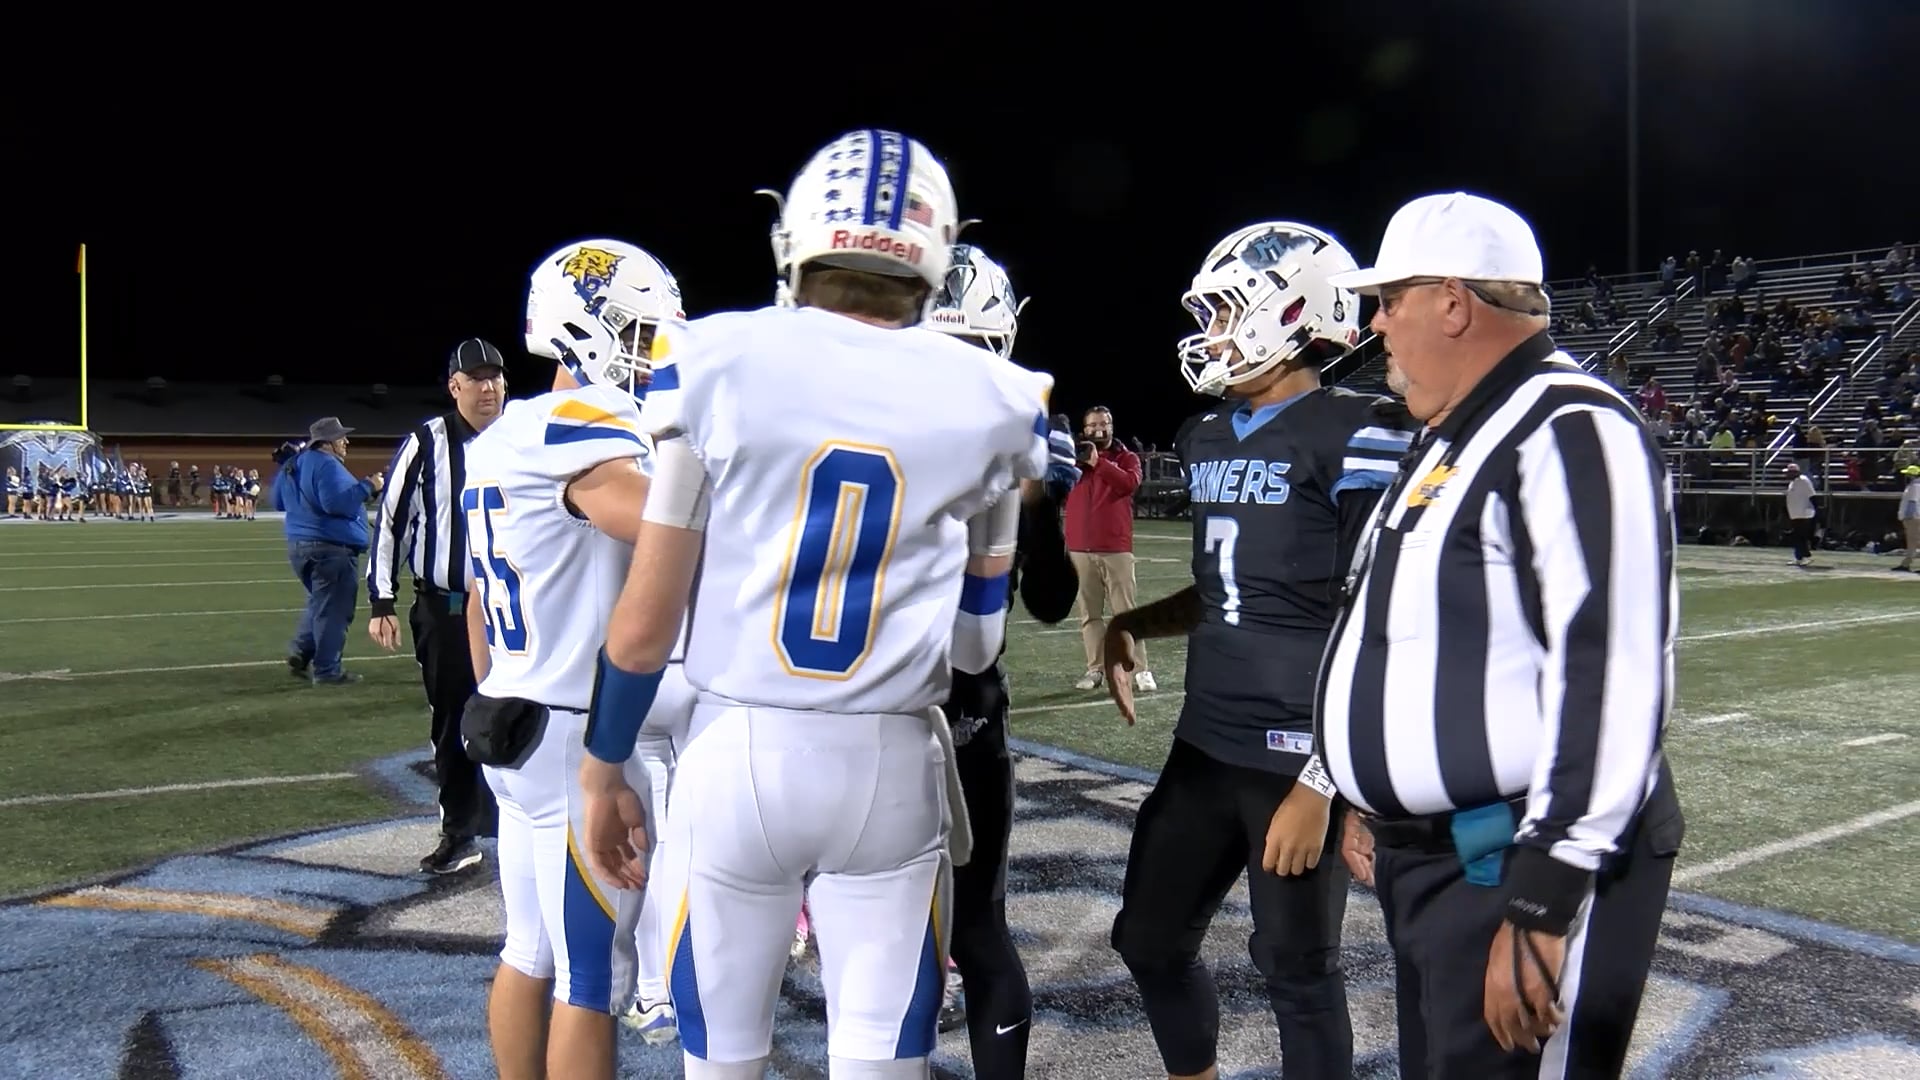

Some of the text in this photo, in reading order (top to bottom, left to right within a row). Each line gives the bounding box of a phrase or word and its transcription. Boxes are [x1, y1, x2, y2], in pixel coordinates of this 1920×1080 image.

[831, 229, 924, 265] Riddell
[931, 312, 966, 325] iddell
[770, 440, 906, 681] 0
[1204, 515, 1241, 627] 7
